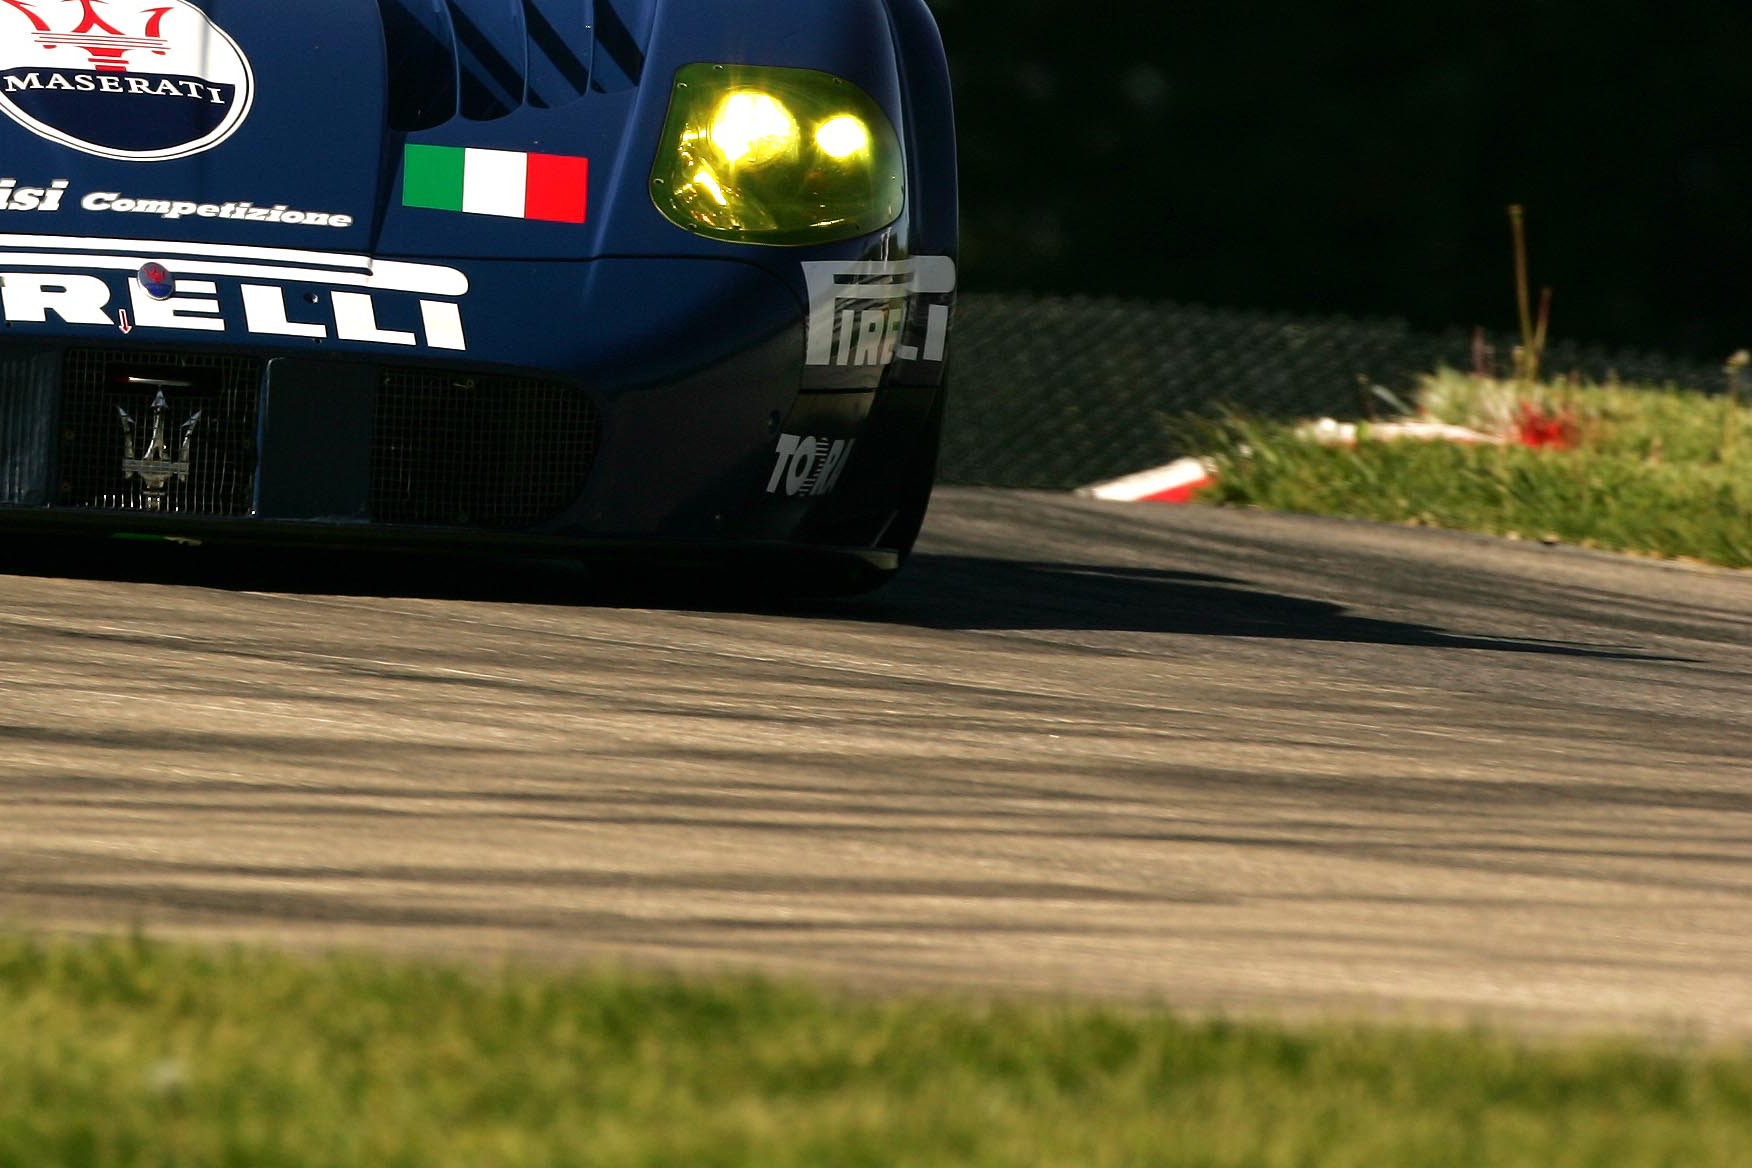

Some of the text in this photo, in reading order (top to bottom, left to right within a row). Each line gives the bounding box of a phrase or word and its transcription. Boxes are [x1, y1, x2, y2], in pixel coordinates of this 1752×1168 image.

[4, 72, 227, 105] MASERATI
[81, 192, 352, 228] Competizione
[800, 255, 956, 365] PIREI
